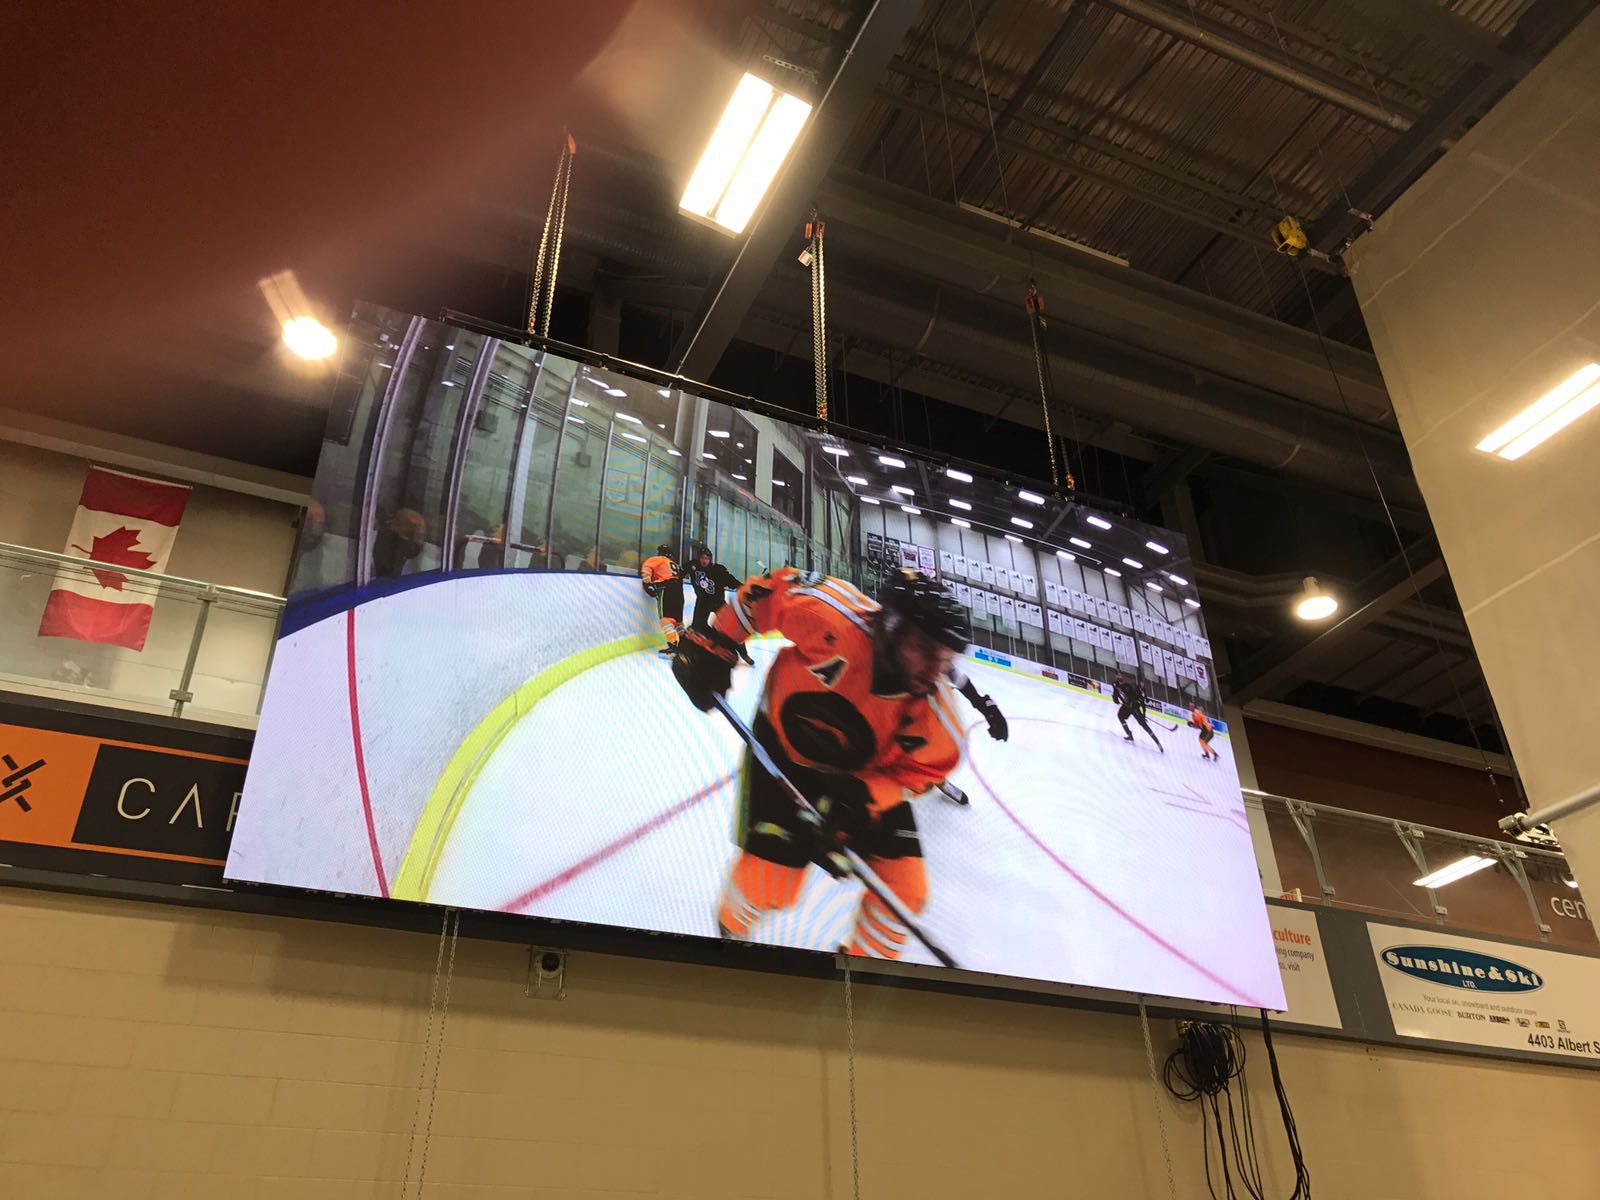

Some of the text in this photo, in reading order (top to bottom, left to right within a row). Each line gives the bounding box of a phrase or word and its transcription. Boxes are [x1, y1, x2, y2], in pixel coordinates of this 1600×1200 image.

[1273, 928, 1312, 945] culture
[1392, 1002, 1453, 1017] CANADA GOOSE
[1457, 1011, 1487, 1021] BURTON
[1528, 1033, 1555, 1049] 4403
[1558, 1037, 1592, 1053] Albert
